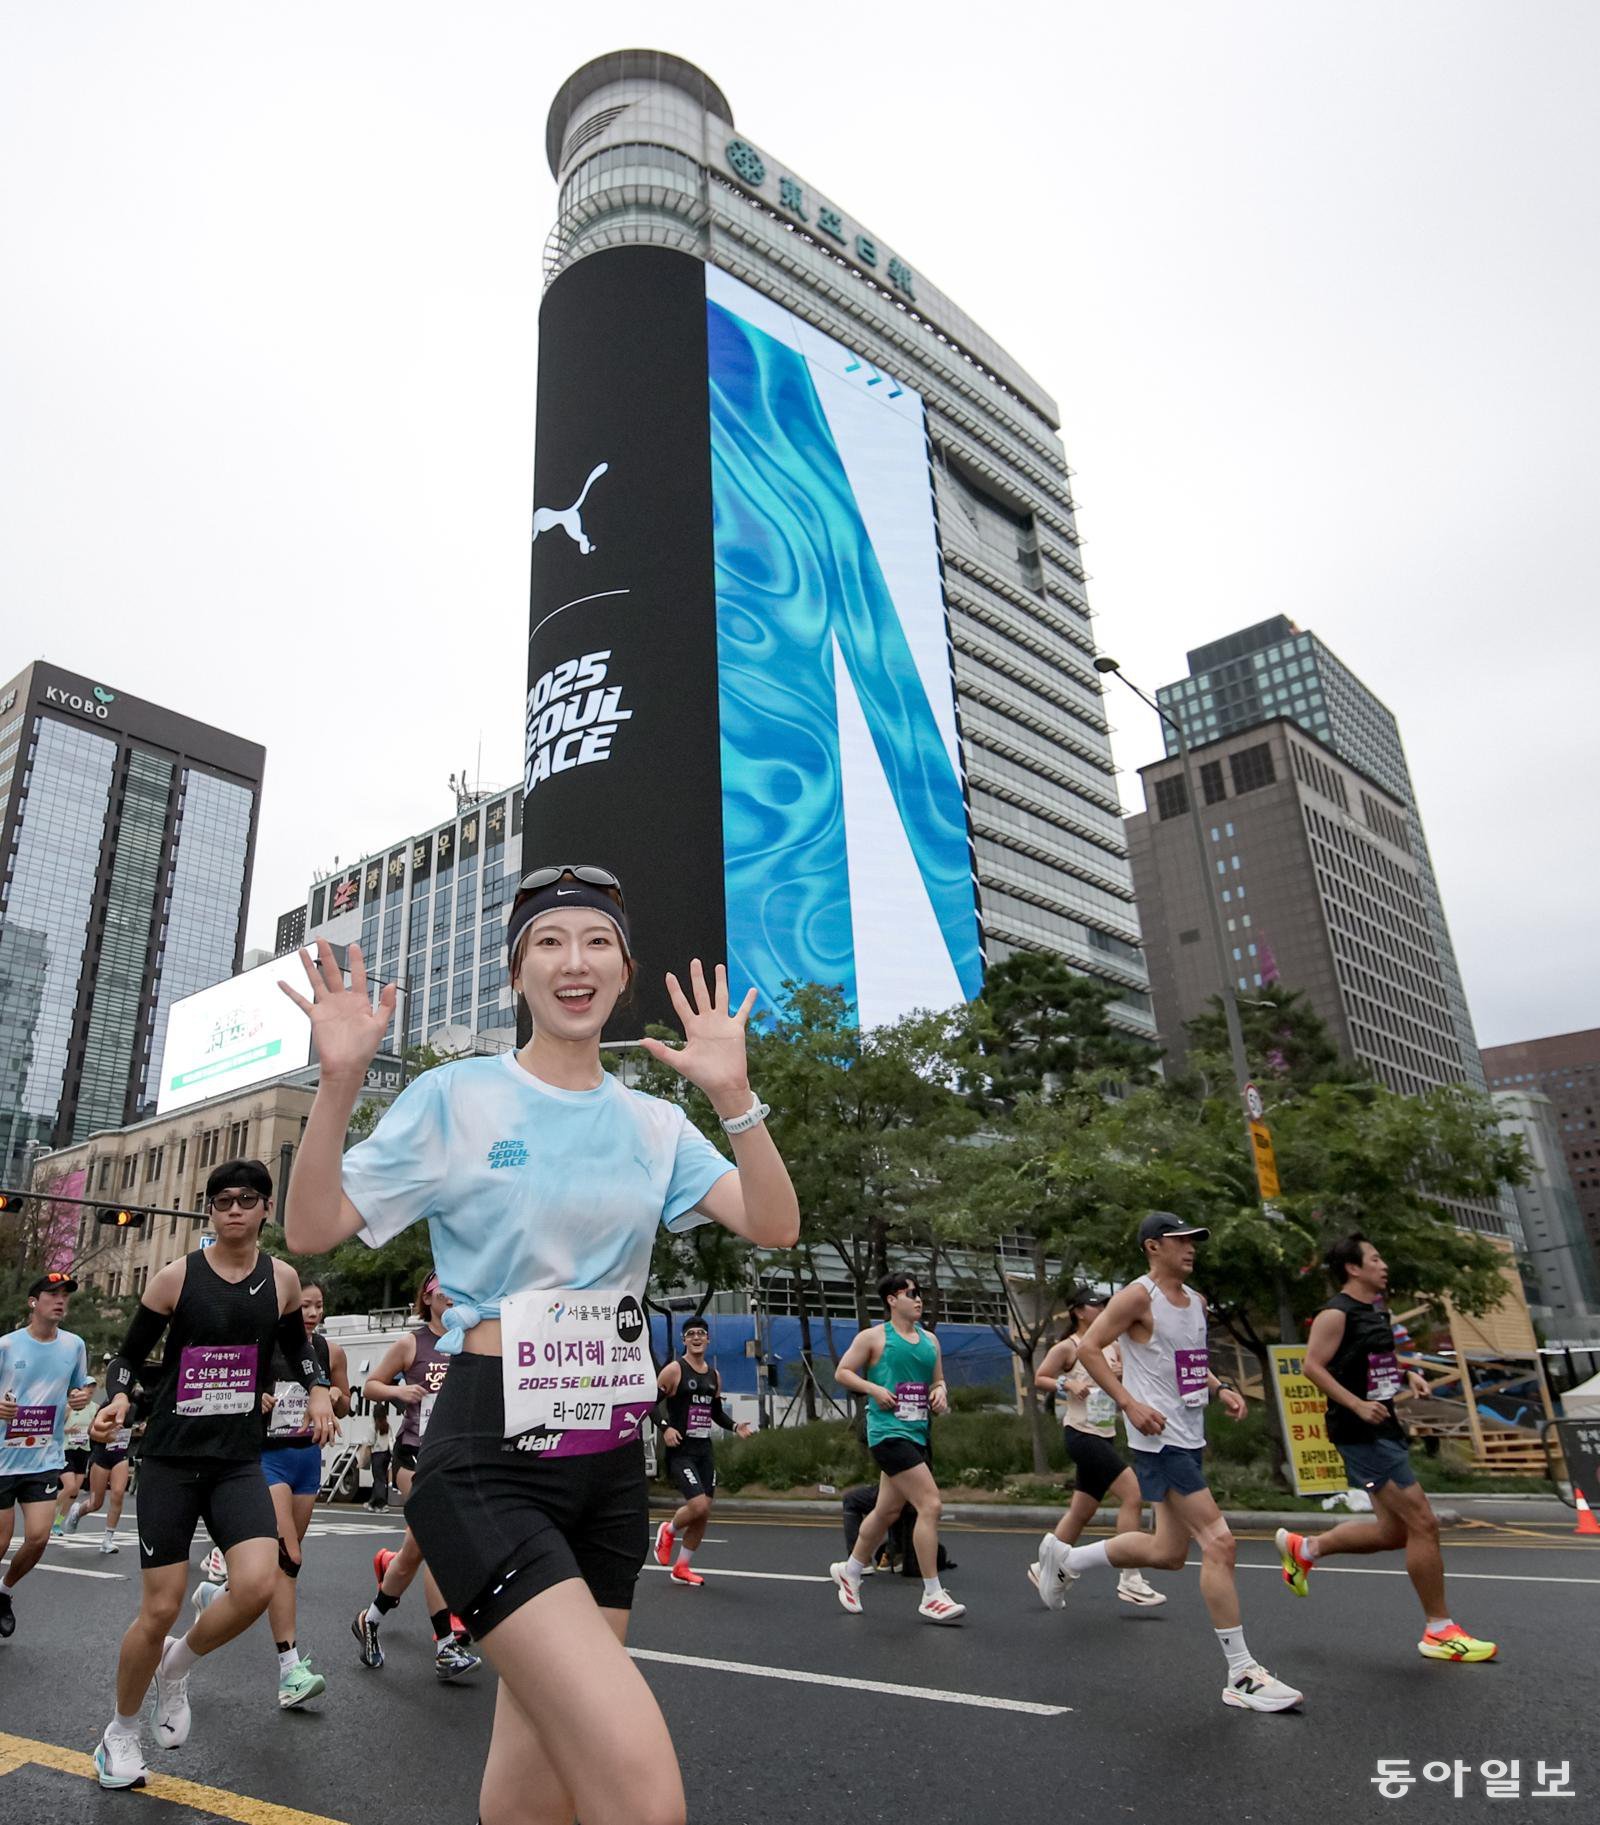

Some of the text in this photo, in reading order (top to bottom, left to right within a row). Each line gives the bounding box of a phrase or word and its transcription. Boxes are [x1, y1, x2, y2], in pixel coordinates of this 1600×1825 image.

[46, 685, 109, 719] KYOBO
[491, 1140, 524, 1150] 2025
[487, 1149, 530, 1161] SEOUL
[491, 1158, 527, 1169] RACE
[618, 1309, 642, 1330] FRL
[518, 1340, 641, 1367] B 이지혜 27240
[185, 1368, 195, 1380] C
[198, 1367, 228, 1380] 신우철
[518, 1373, 645, 1390] 2025 SEOUL RACE
[182, 1406, 203, 1414] Half
[278, 1400, 285, 1408] A
[553, 1401, 605, 1422] 라-0277
[517, 1433, 563, 1451] Half
